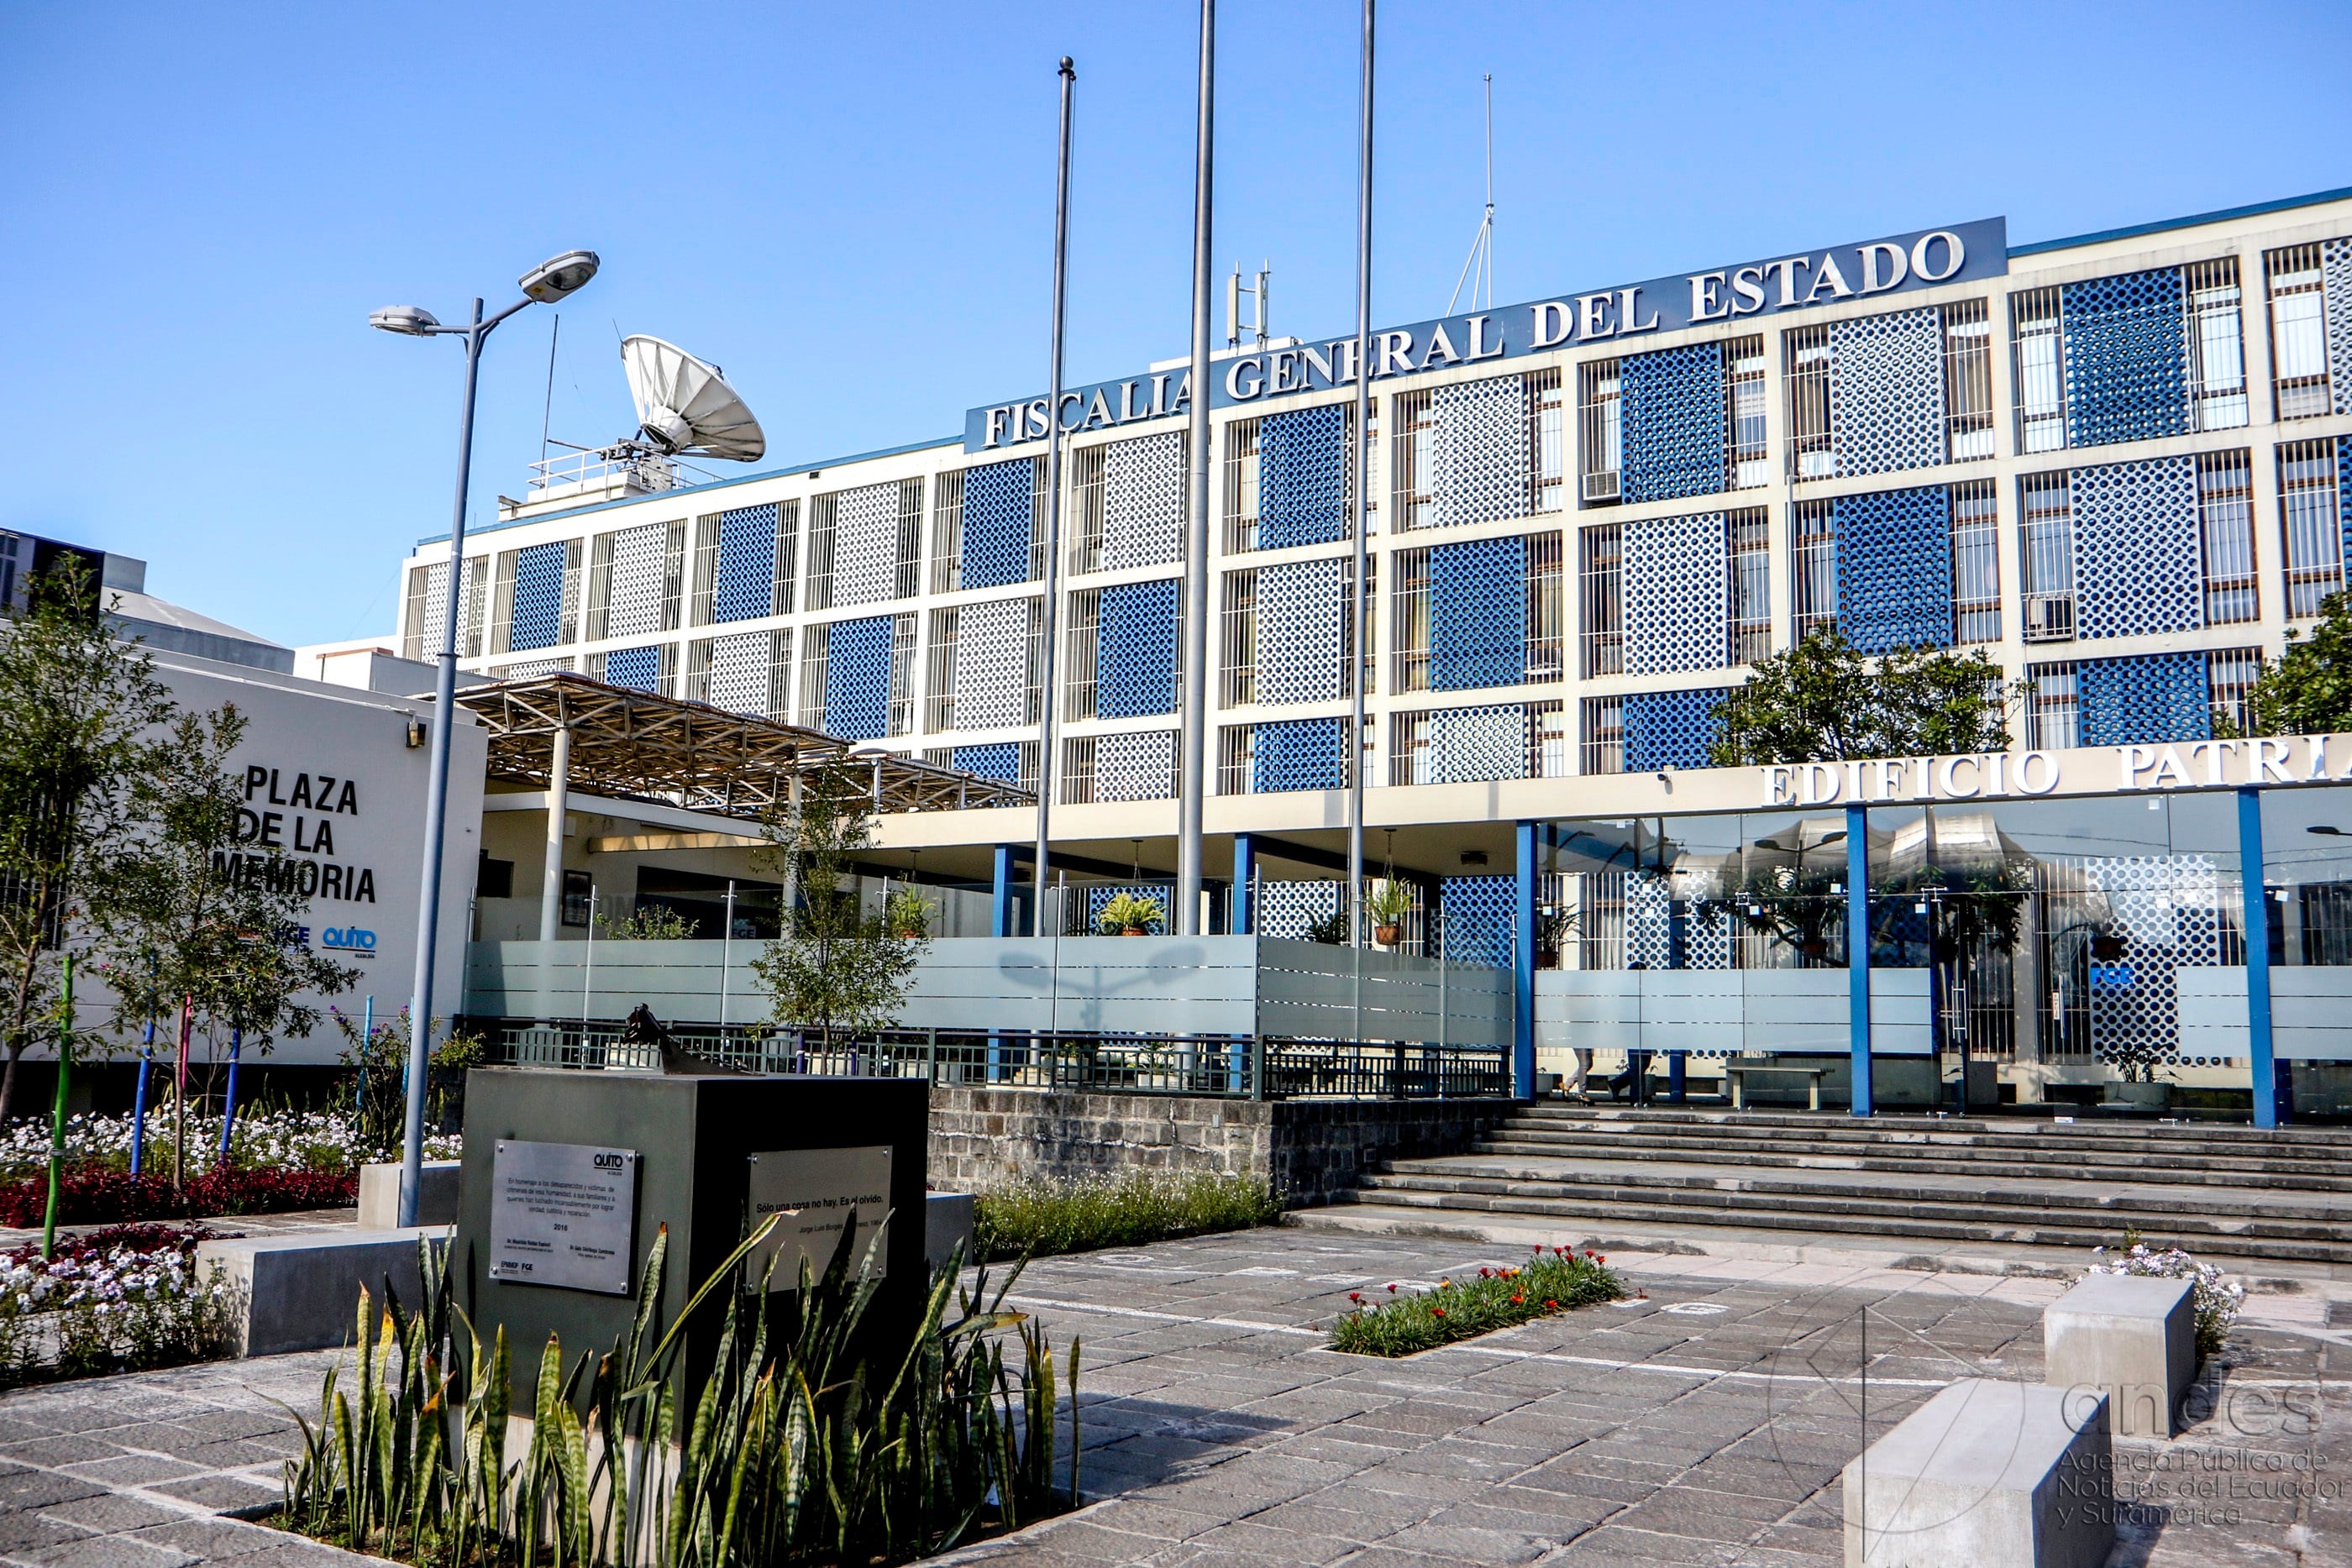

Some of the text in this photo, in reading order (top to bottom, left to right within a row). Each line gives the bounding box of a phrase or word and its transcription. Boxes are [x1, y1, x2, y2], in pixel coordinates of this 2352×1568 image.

[980, 230, 1966, 448] FISCALIA GENERAL DEL ESTADO
[245, 765, 358, 815] PLAZA
[1761, 754, 2060, 806] EDIFICIO
[230, 808, 334, 856] DE LA
[212, 851, 375, 904] MEMORIA
[2090, 967, 2134, 984] FGE
[554, 1223, 568, 1231] 2016
[757, 1202, 774, 1214] Sólo
[775, 1203, 790, 1211] una
[791, 1201, 810, 1210] cosa
[823, 1197, 837, 1209] hay.
[840, 1196, 849, 1205] Es
[859, 1193, 883, 1204] olvido.
